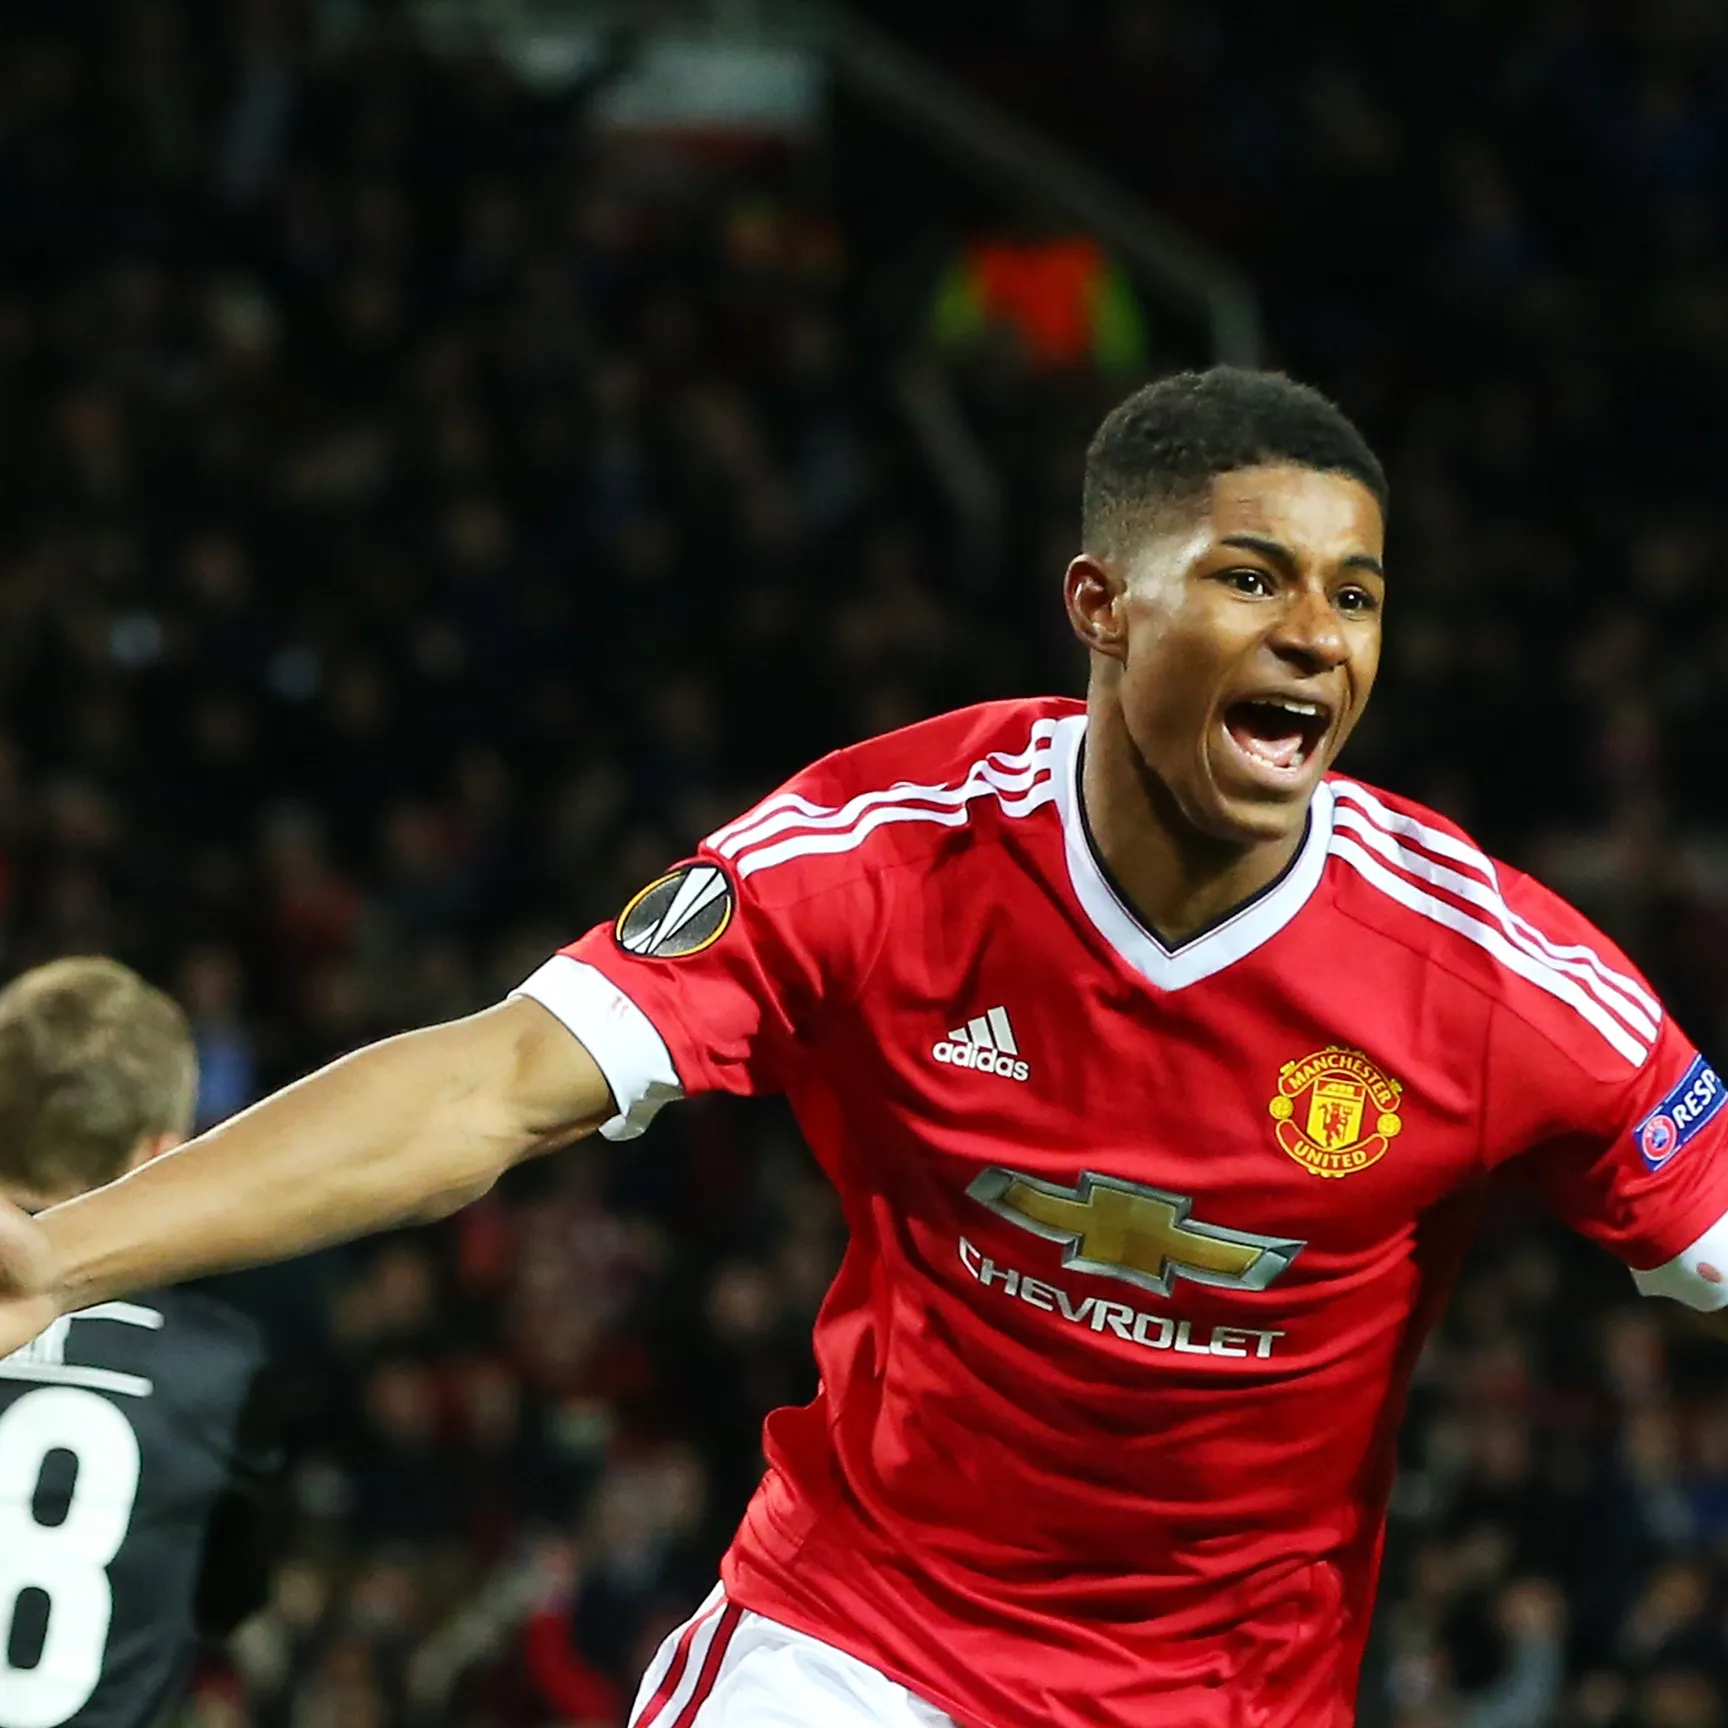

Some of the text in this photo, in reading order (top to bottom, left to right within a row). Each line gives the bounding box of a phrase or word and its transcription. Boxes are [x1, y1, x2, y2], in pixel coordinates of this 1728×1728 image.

[932, 1041, 1030, 1082] adidas
[1287, 1054, 1393, 1104] MANCHESTER
[1673, 1068, 1721, 1129] RESP
[1294, 1140, 1367, 1169] UNITED
[959, 1236, 1286, 1359] CHEVROLET
